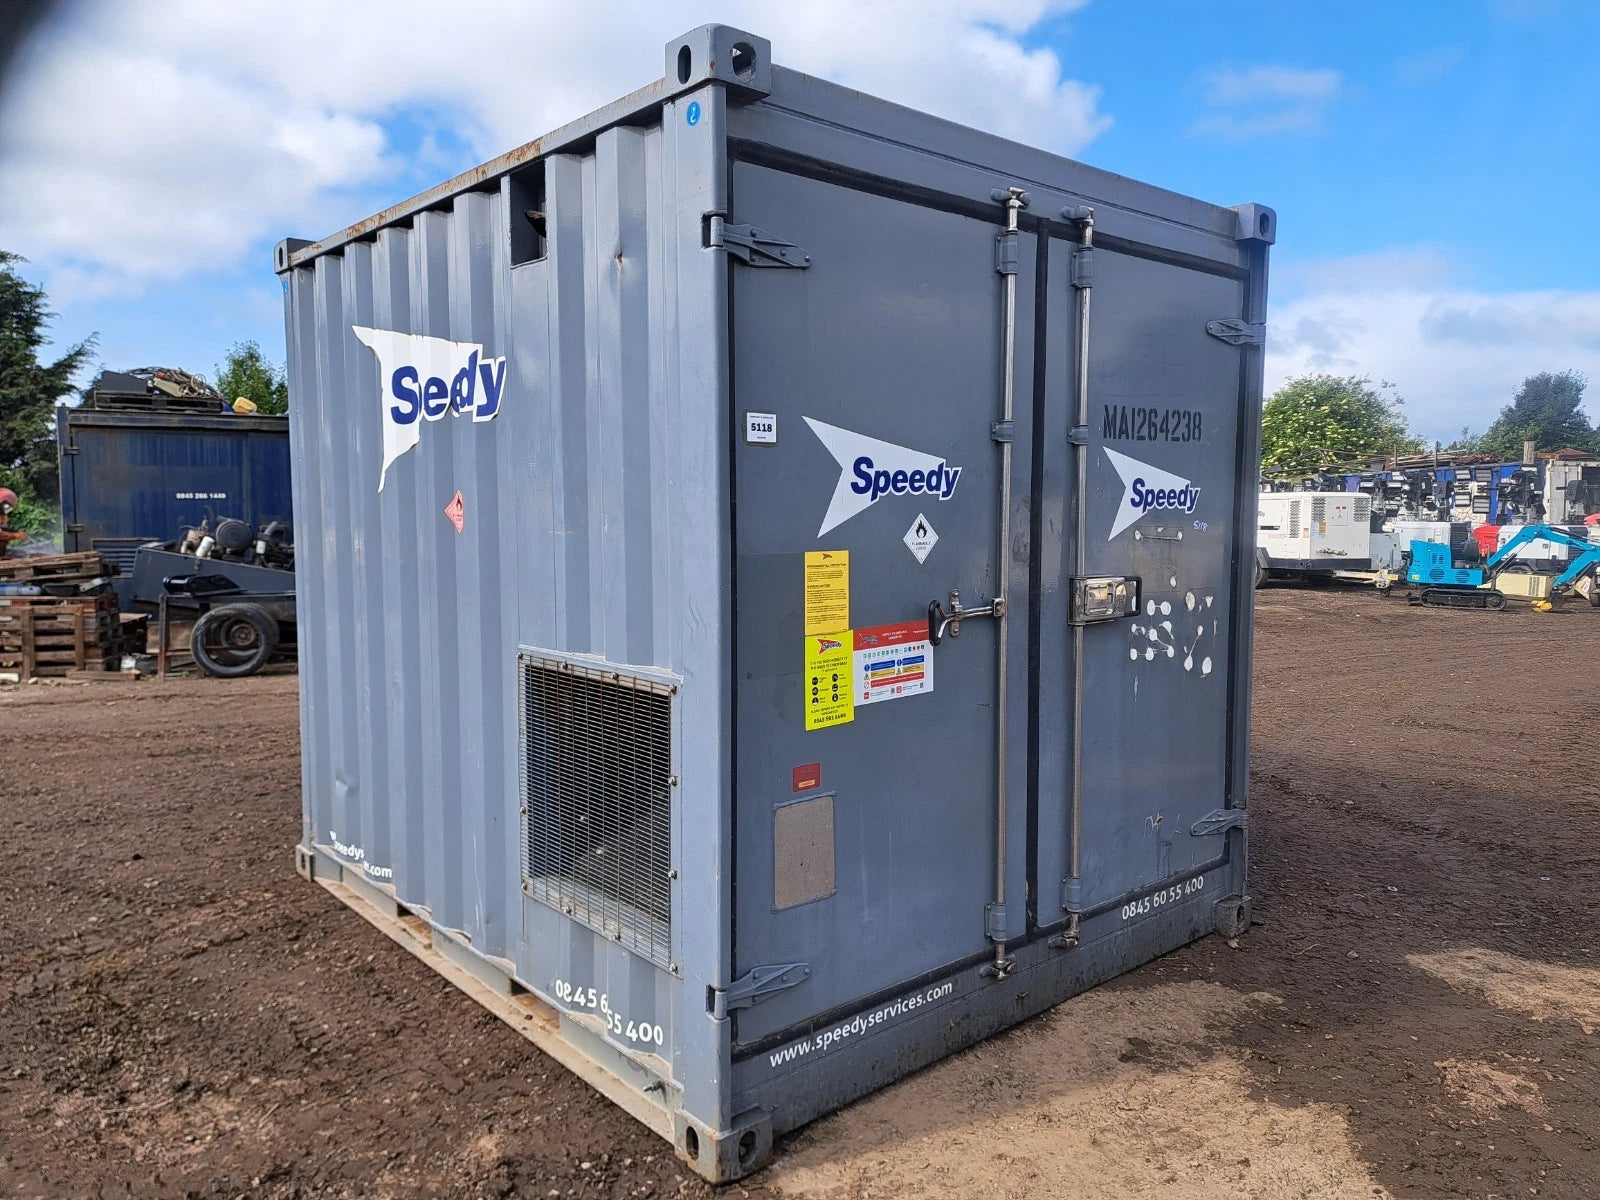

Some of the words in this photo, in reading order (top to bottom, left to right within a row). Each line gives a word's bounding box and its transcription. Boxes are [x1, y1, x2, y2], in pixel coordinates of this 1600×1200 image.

[750, 422, 773, 433] 5118
[850, 456, 960, 503] Speedy
[1130, 477, 1200, 512] Speedy
[1122, 897, 1150, 920] 0845
[1153, 890, 1167, 907] 60
[1169, 884, 1182, 903] 55
[1184, 875, 1204, 895] 400
[625, 1020, 664, 1046] 400
[769, 982, 953, 1068] www.speedyservices.com
